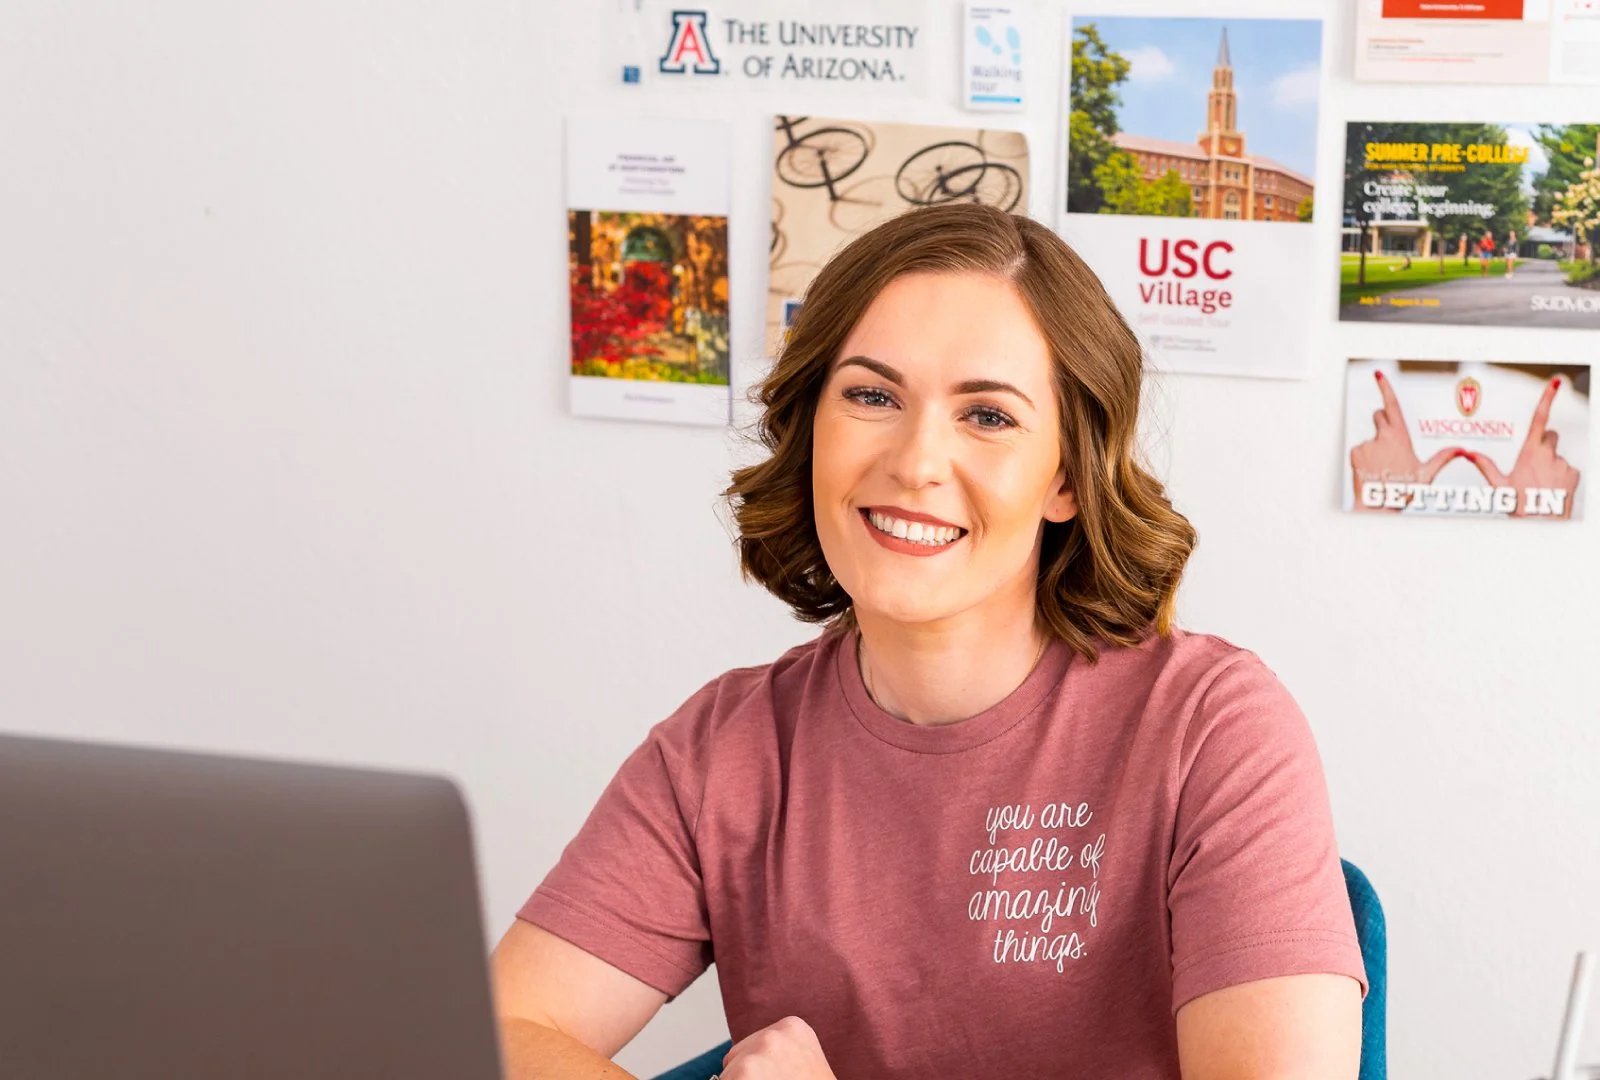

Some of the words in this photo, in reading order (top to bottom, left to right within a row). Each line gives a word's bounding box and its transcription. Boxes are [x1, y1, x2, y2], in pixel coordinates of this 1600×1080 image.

[723, 18, 769, 46] THE
[778, 21, 919, 50] UNIVERSITY
[743, 55, 774, 79] OF
[1365, 142, 1429, 162] SUMMER
[1431, 143, 1530, 164] PRE-COLLEGE
[1363, 181, 1415, 198] Create
[1414, 184, 1449, 201] your
[1362, 200, 1416, 216] college
[1138, 237, 1234, 281] USC
[1138, 281, 1233, 314] Village
[1418, 419, 1515, 436] WISCONSIN
[1361, 482, 1518, 514] GETTING
[1524, 487, 1567, 515] IN
[986, 804, 1035, 845] you
[1040, 802, 1093, 829] are
[969, 837, 1074, 886] capable
[1080, 833, 1106, 879] of
[968, 881, 1101, 933] amazing
[993, 929, 1088, 974] things.
